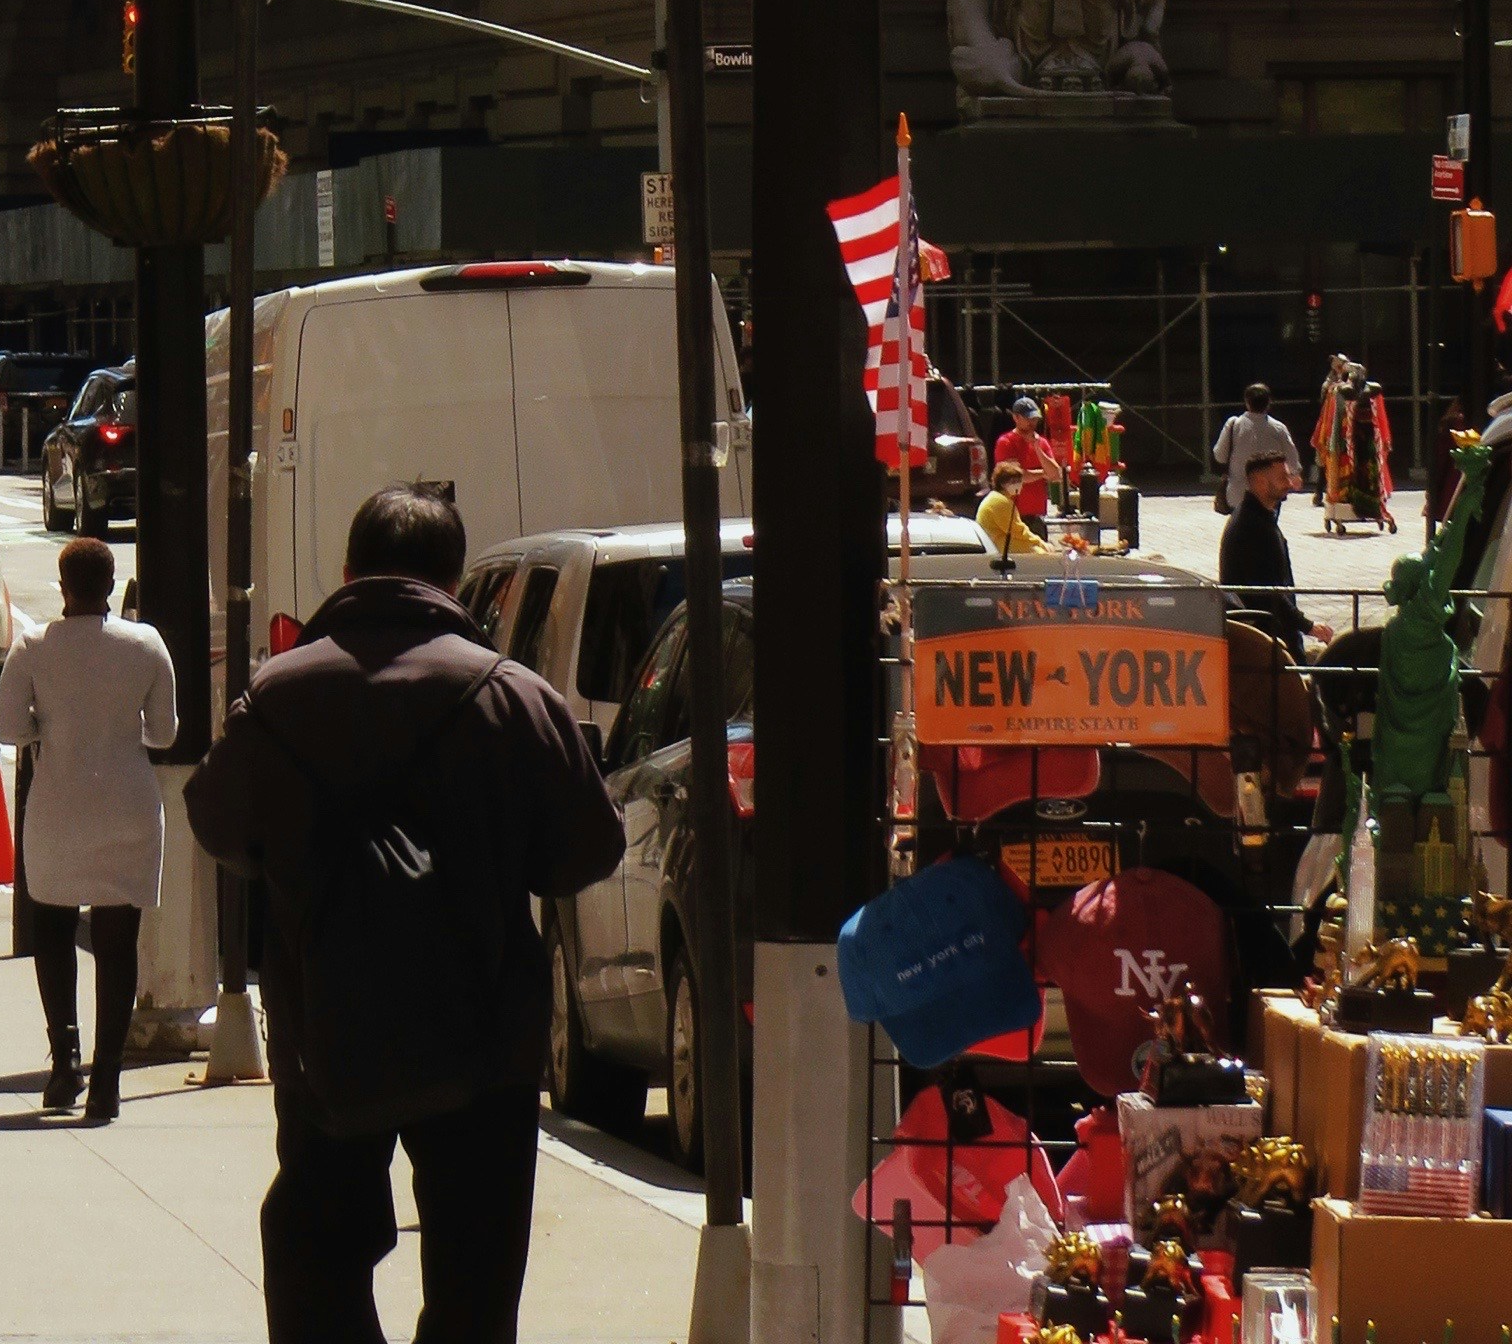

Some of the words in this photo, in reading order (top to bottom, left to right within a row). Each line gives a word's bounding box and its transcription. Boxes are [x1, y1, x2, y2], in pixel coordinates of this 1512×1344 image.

[659, 211, 675, 223] RE
[935, 649, 1037, 708] NEW
[1078, 649, 1208, 708] YORK
[1005, 716, 1076, 732] EMPIRE
[1079, 716, 1139, 732] STATE
[896, 962, 923, 983] new
[928, 944, 960, 970] york
[963, 933, 986, 950] city
